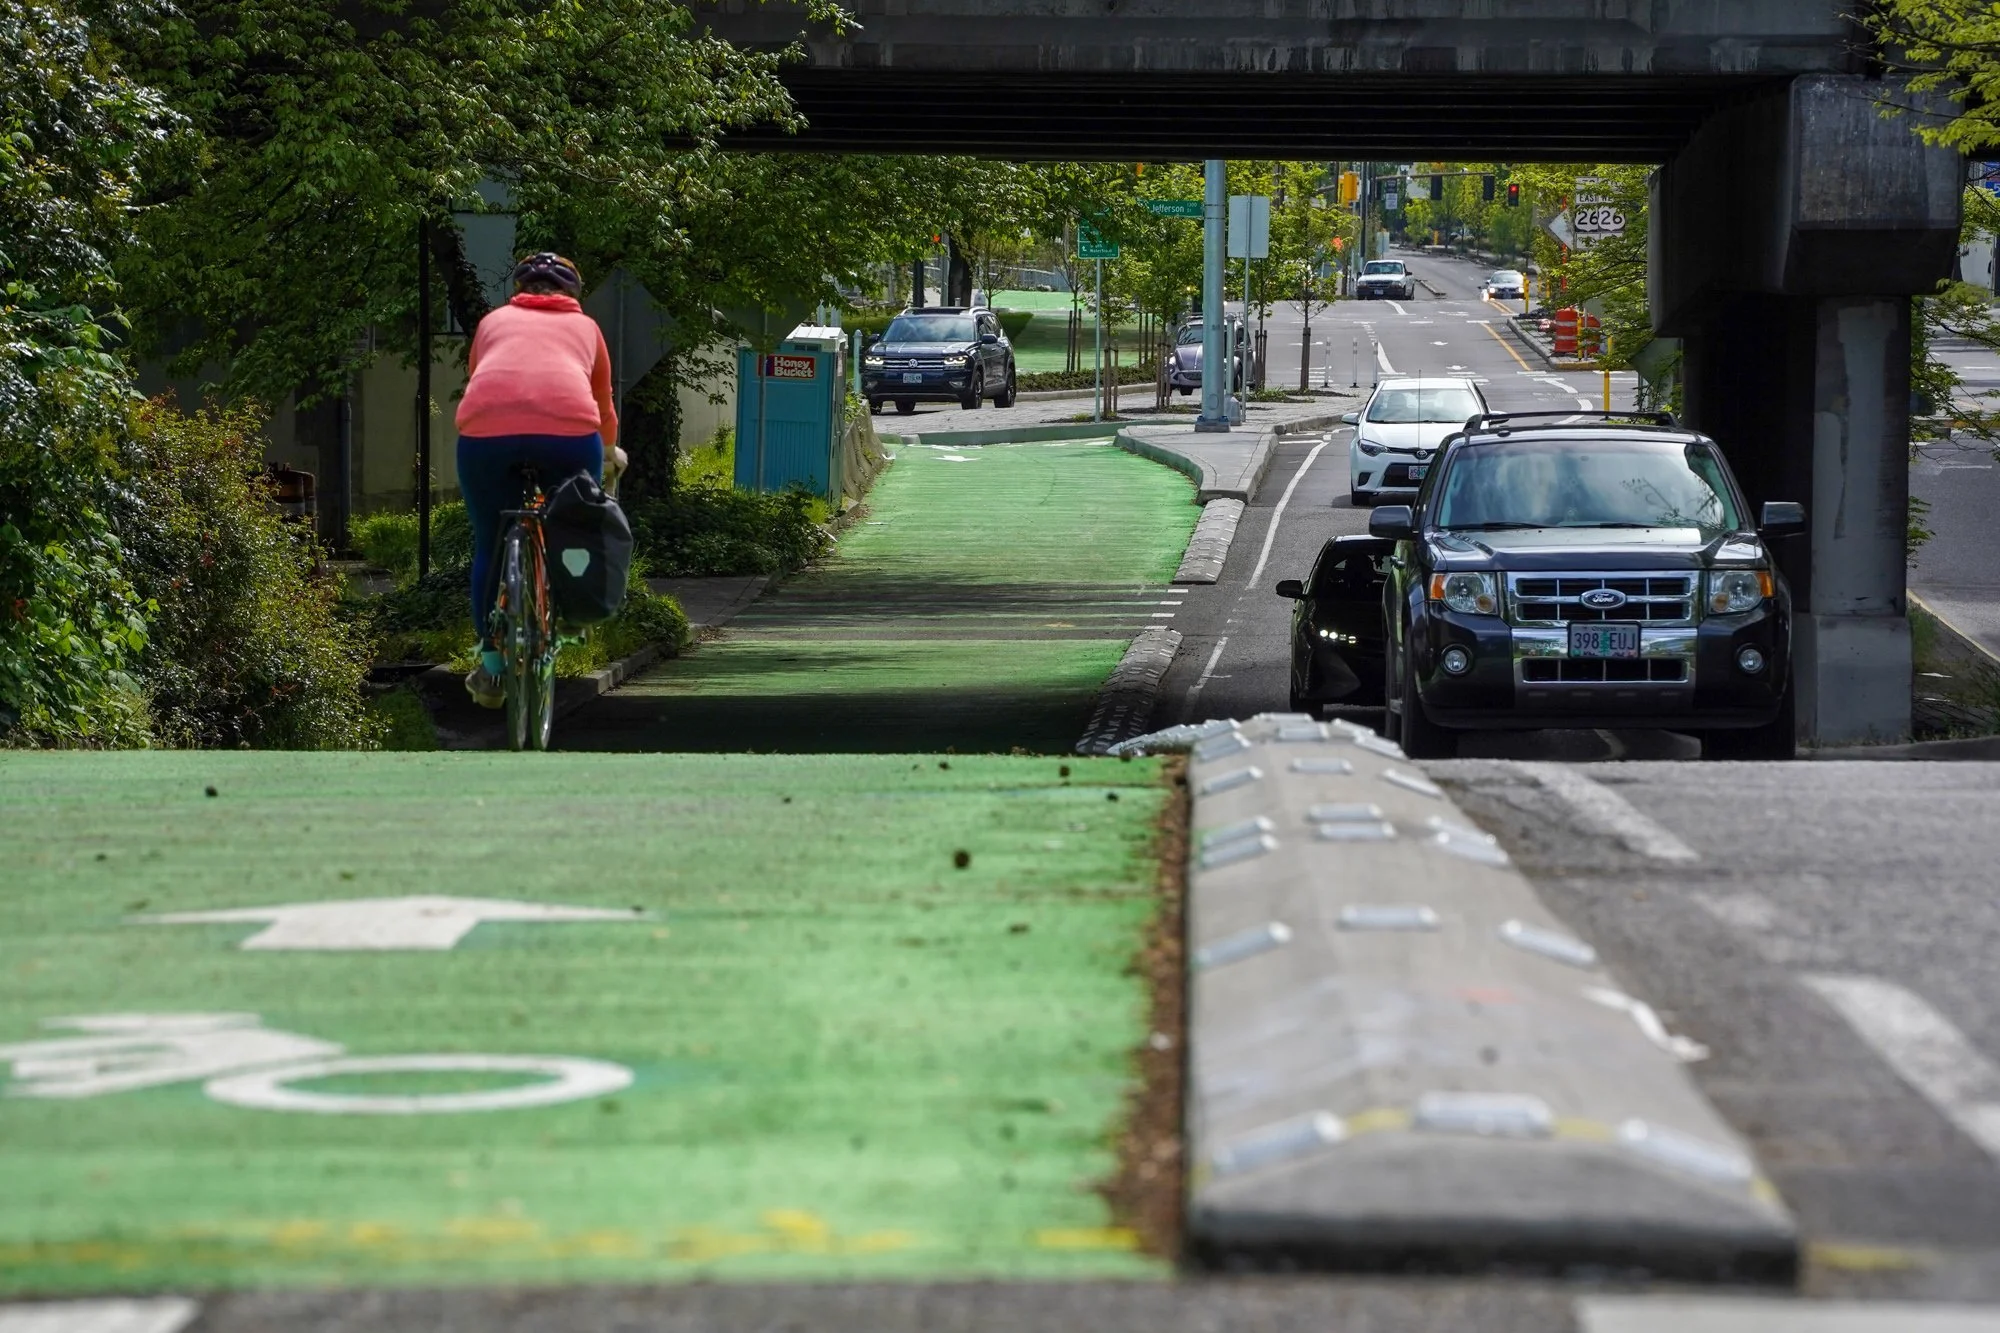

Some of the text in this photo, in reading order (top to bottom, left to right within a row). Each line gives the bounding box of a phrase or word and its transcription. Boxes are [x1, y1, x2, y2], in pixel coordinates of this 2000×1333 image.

[1151, 204, 1185, 213] Jefferson
[1577, 210, 1599, 225] 26
[1600, 210, 1623, 225] 26
[774, 356, 810, 370] Honey
[774, 366, 814, 378] Bucket
[1592, 592, 1615, 603] Ford
[1574, 632, 1636, 650] 398 EUJ
